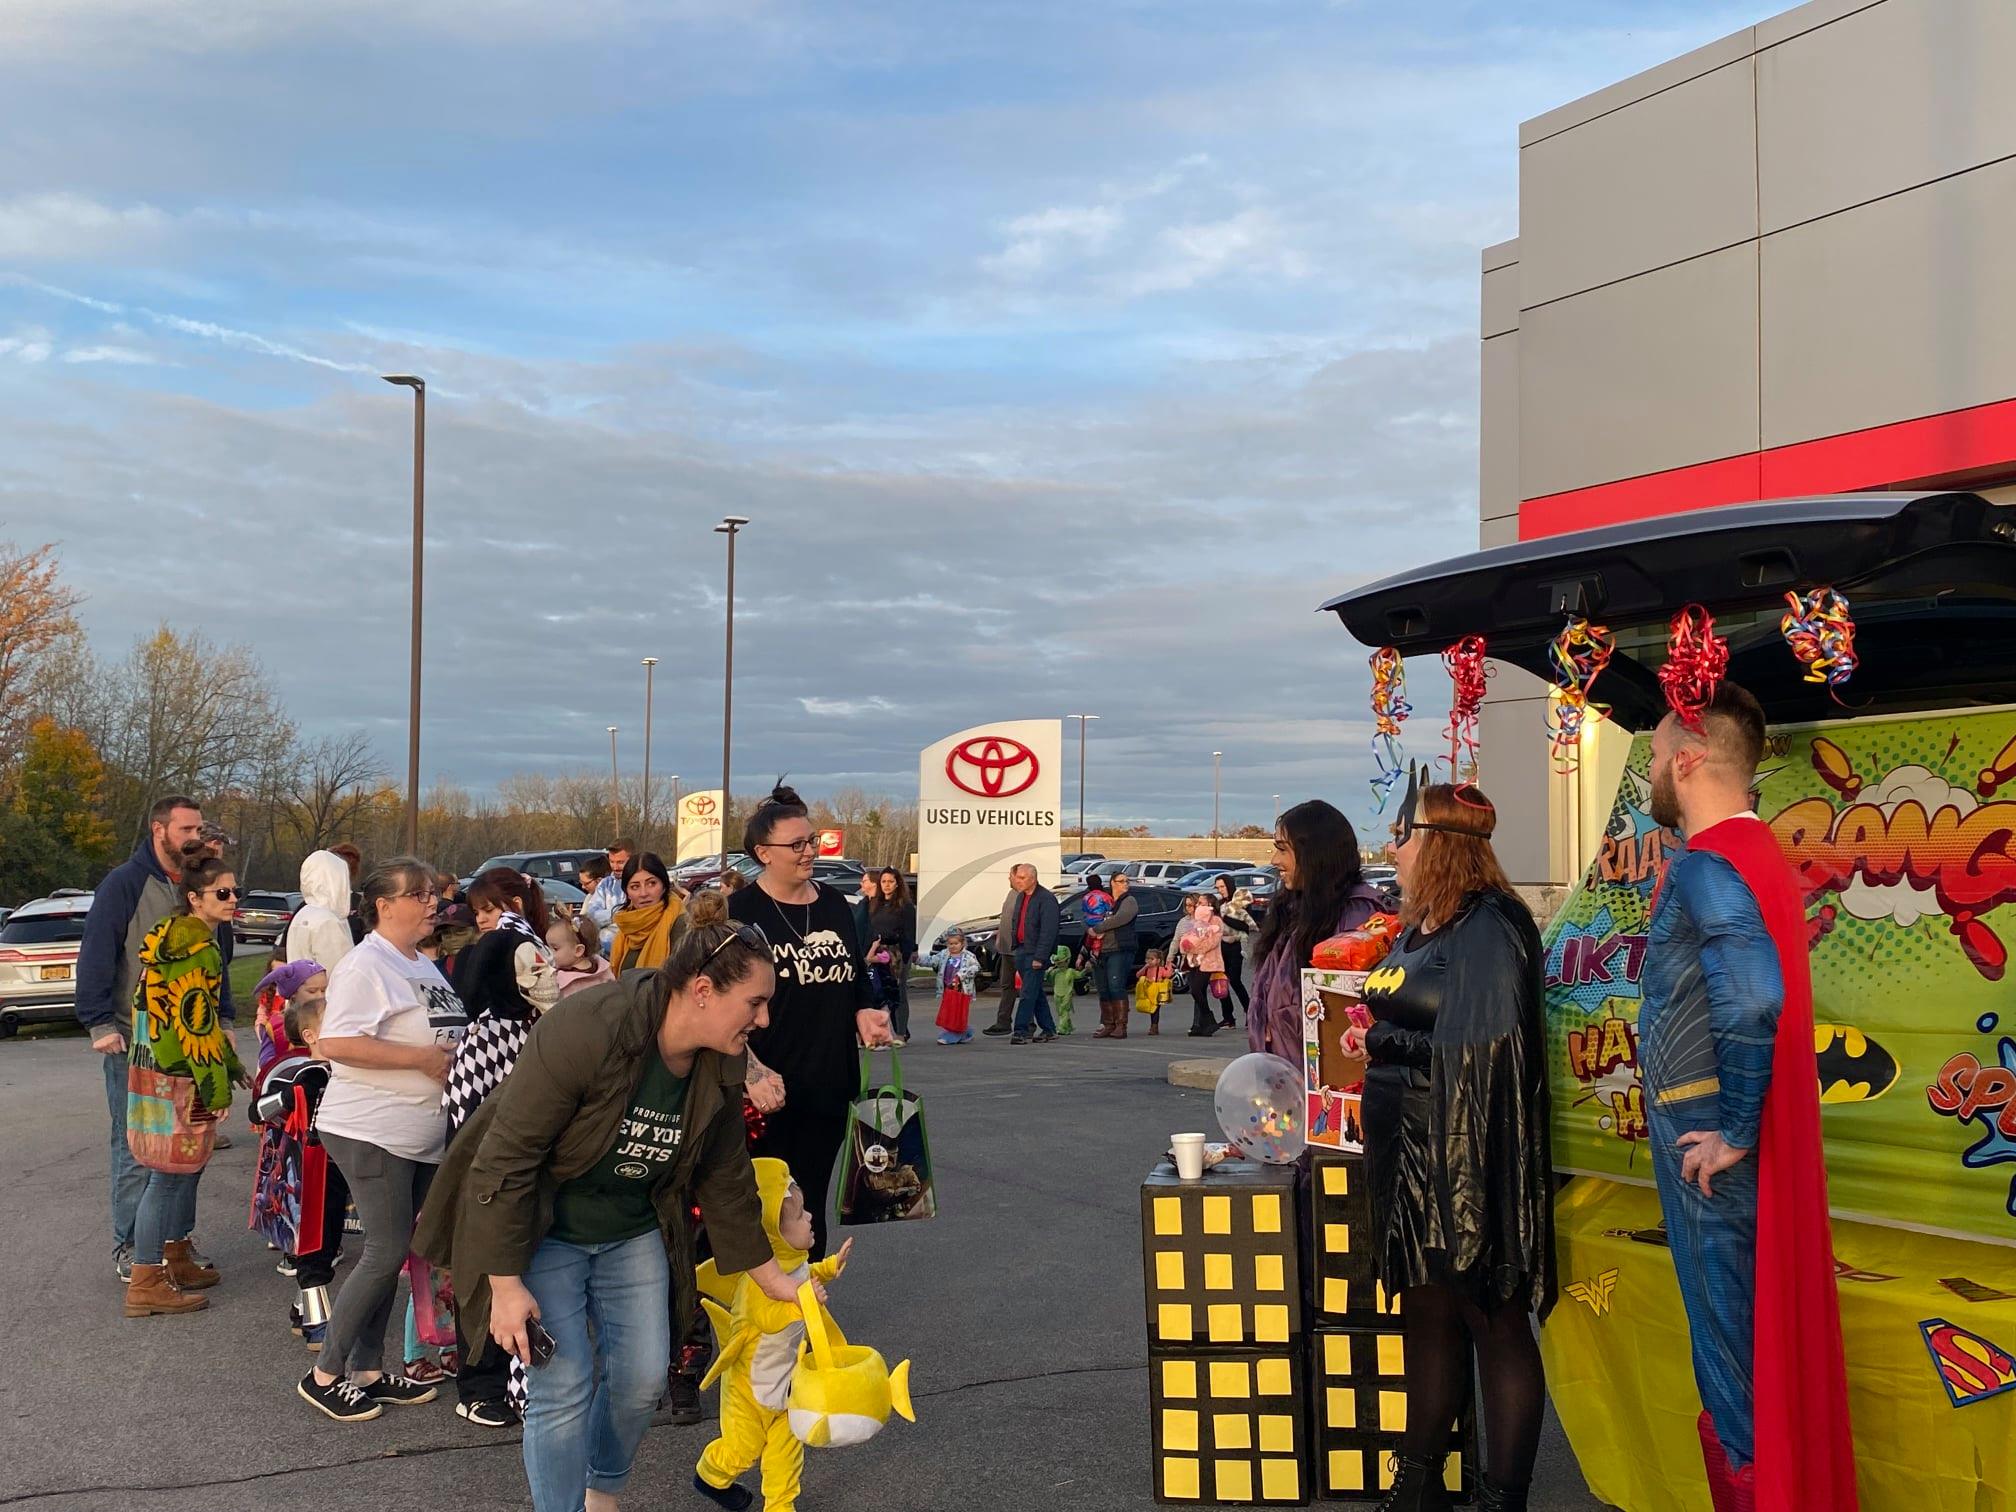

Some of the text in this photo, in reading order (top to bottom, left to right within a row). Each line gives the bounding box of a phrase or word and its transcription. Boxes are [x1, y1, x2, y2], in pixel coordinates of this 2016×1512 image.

[926, 809, 1055, 826] USED VEHICLES
[773, 942, 852, 963] Mama
[1545, 934, 1650, 988] IKT
[793, 958, 856, 986] Bear
[1568, 1017, 1643, 1083] HA
[616, 1141, 673, 1162] JETS
